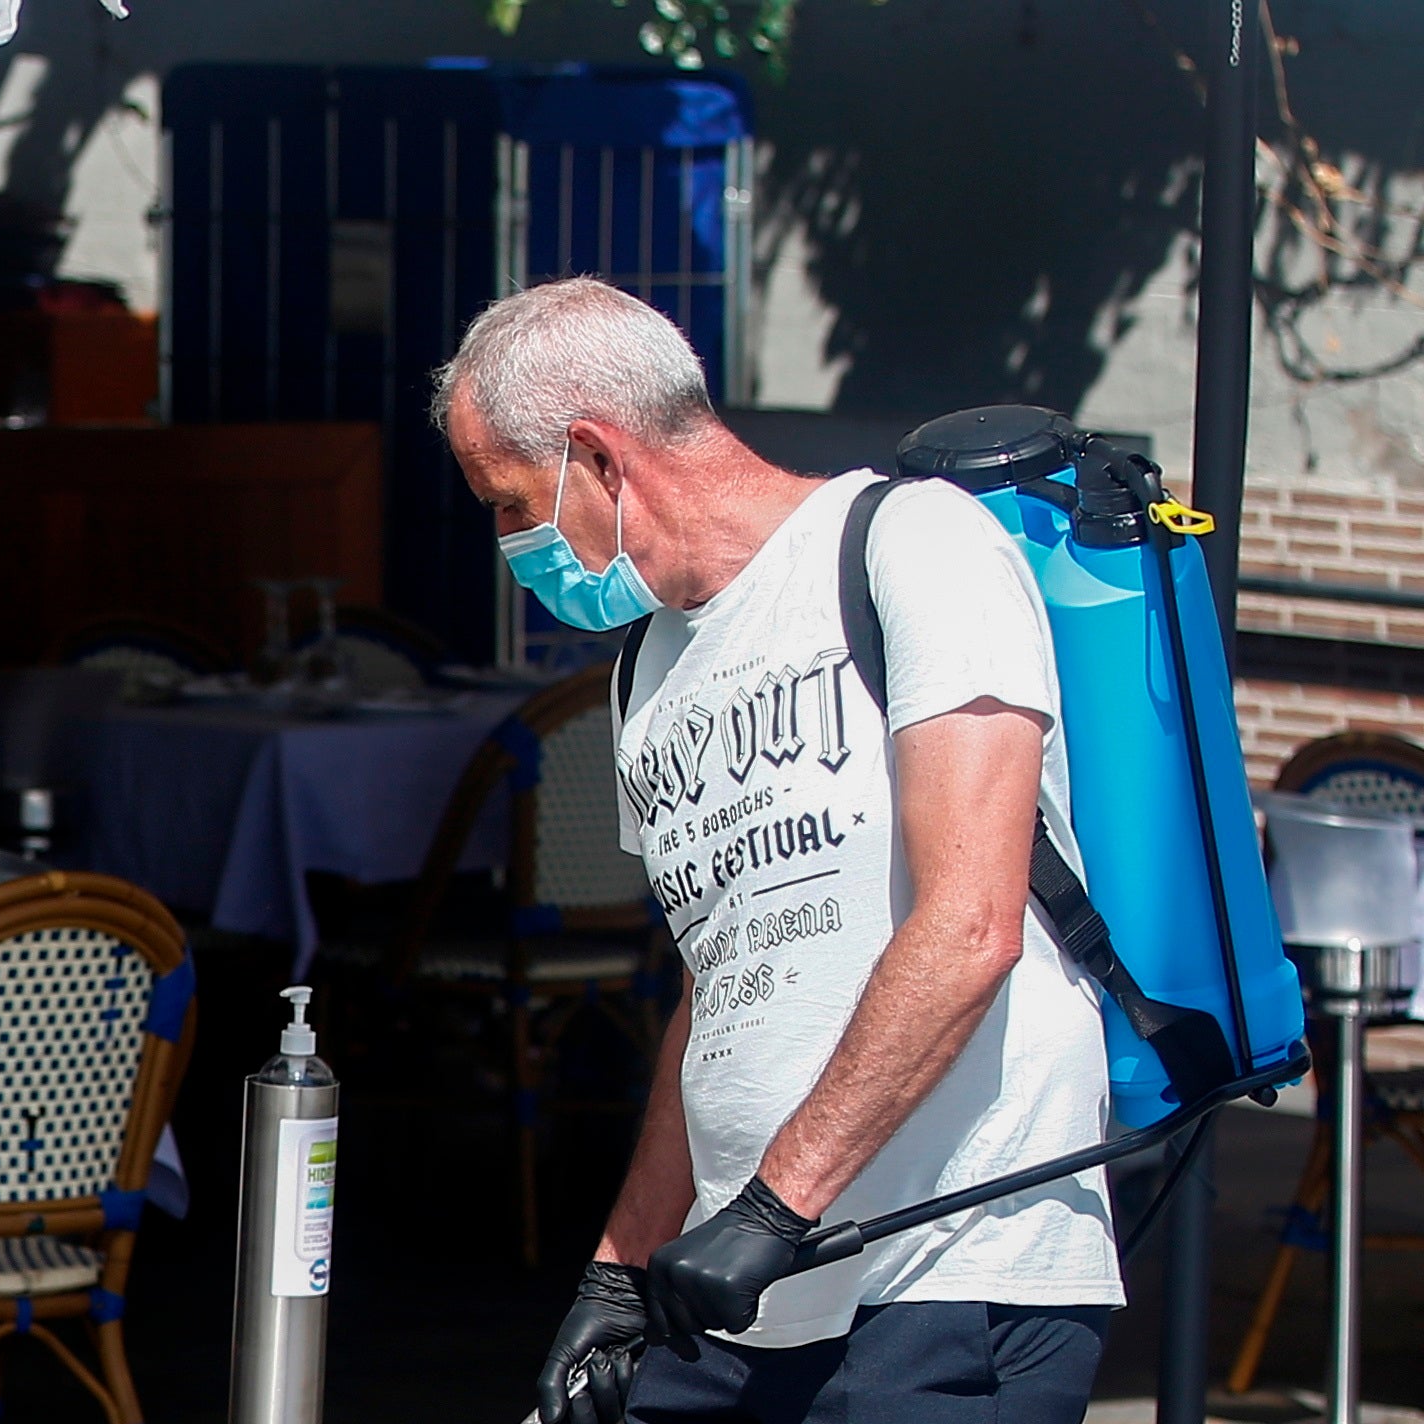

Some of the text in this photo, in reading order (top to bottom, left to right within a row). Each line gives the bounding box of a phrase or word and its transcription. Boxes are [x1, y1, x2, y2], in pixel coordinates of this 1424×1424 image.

[652, 806, 846, 916] USIC FESTIVAL
[658, 829, 681, 857] THE
[685, 821, 697, 843] 5
[728, 892, 745, 910] AT
[746, 897, 844, 954] ARENA
